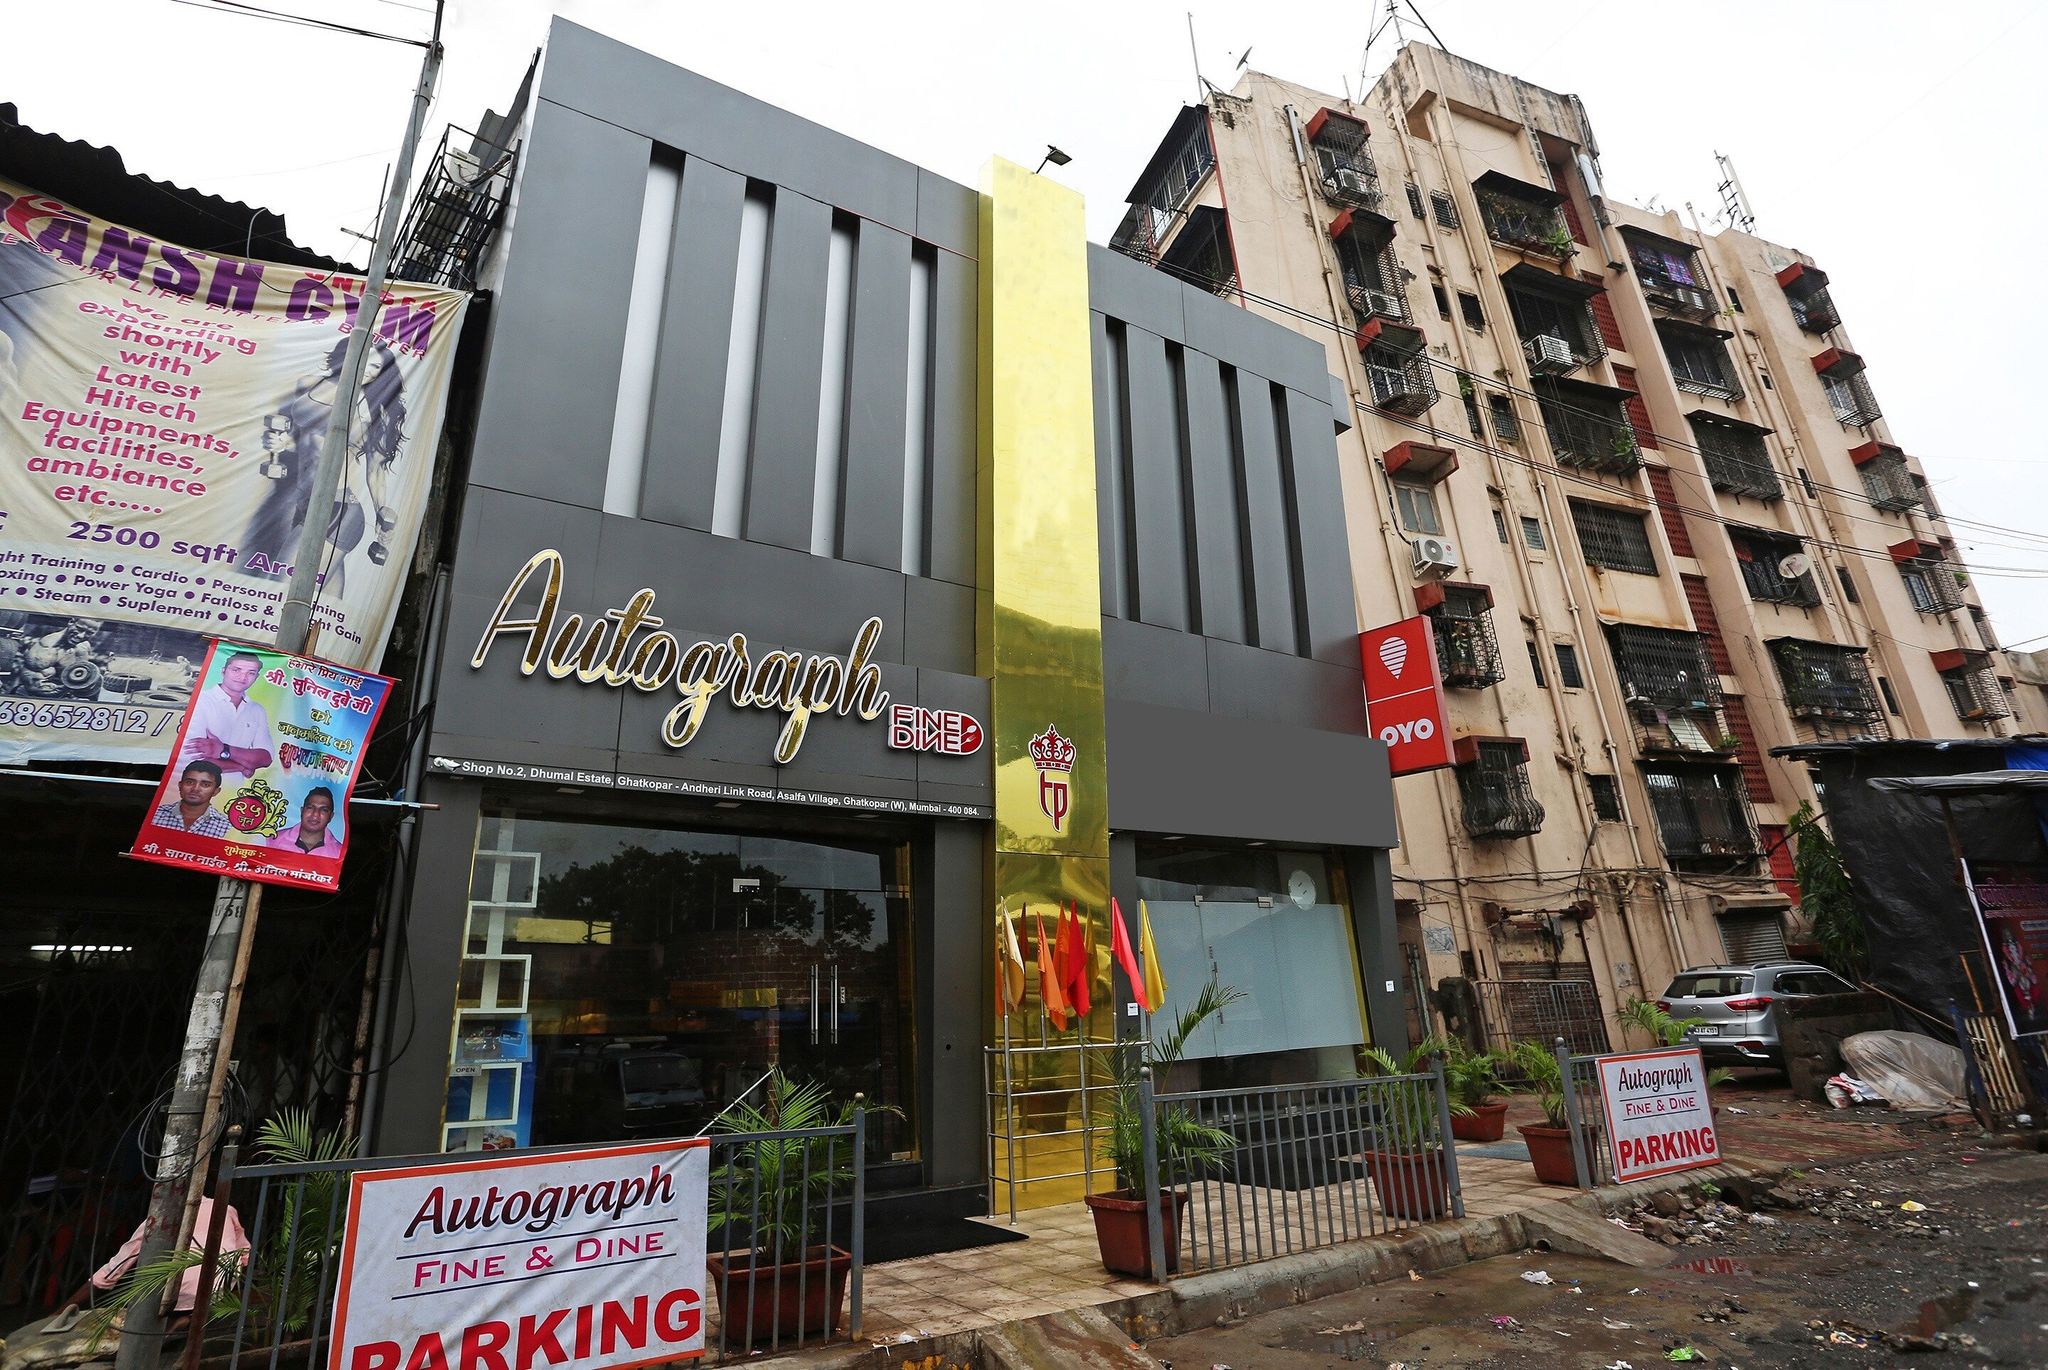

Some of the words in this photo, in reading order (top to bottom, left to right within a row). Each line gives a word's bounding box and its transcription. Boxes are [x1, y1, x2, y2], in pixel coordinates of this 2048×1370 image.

[78, 300, 257, 356] expanding
[121, 297, 169, 321] We
[181, 318, 234, 330] are
[129, 281, 194, 306] LIFE
[338, 322, 426, 361] BTTER
[103, 325, 222, 365] shortly
[119, 350, 192, 377] with
[95, 365, 202, 401] Latest
[84, 386, 196, 424] Hitech
[21, 401, 240, 460] Equipments,
[44, 428, 205, 476] facilities,
[26, 456, 208, 497] ambiance
[66, 521, 161, 549] 2500
[171, 540, 238, 564] sqft
[31, 553, 106, 575] Training
[131, 566, 189, 585] Cardio
[212, 579, 283, 603] Personal
[33, 588, 92, 604] Steam
[117, 596, 212, 620] Suplement
[234, 615, 280, 634] Locke
[73, 574, 130, 591] Power
[135, 581, 177, 599] Yoga
[201, 592, 259, 613] Fatloss
[264, 605, 275, 617] &
[334, 625, 362, 645] Gain
[471, 548, 890, 764] Autograph
[292, 676, 332, 697] सुनिल
[351, 696, 374, 714] जी
[340, 673, 364, 690] भाई
[310, 708, 333, 725] को
[889, 703, 960, 733] FINE
[1379, 718, 1435, 748] OYO
[888, 724, 960, 754] DINE
[462, 761, 494, 775] Shop
[497, 765, 527, 778] No.2,
[530, 768, 574, 781] Dhumal
[577, 772, 614, 785] Estate,
[617, 776, 673, 790] Ghatkopar
[681, 782, 721, 795] Andheri
[723, 786, 745, 797] Link
[747, 788, 775, 801] Road,
[776, 791, 806, 802] Asalfa
[808, 793, 841, 806] Village,
[843, 796, 889, 809] Ghatkopar
[890, 800, 907, 812] (W),
[909, 802, 941, 813] Mumbai
[948, 806, 962, 815] 400
[963, 807, 980, 816] 084.
[164, 848, 196, 862] सागर
[1618, 1062, 1693, 1093] Autograph
[1625, 1102, 1651, 1117] FINE
[1656, 1099, 1666, 1112] &
[1669, 1096, 1696, 1110] DINE
[1618, 1126, 1716, 1170] PARKING
[403, 1164, 676, 1239] Autograph
[414, 1254, 506, 1289] FINE
[525, 1245, 555, 1272] &
[575, 1231, 665, 1263] DINE
